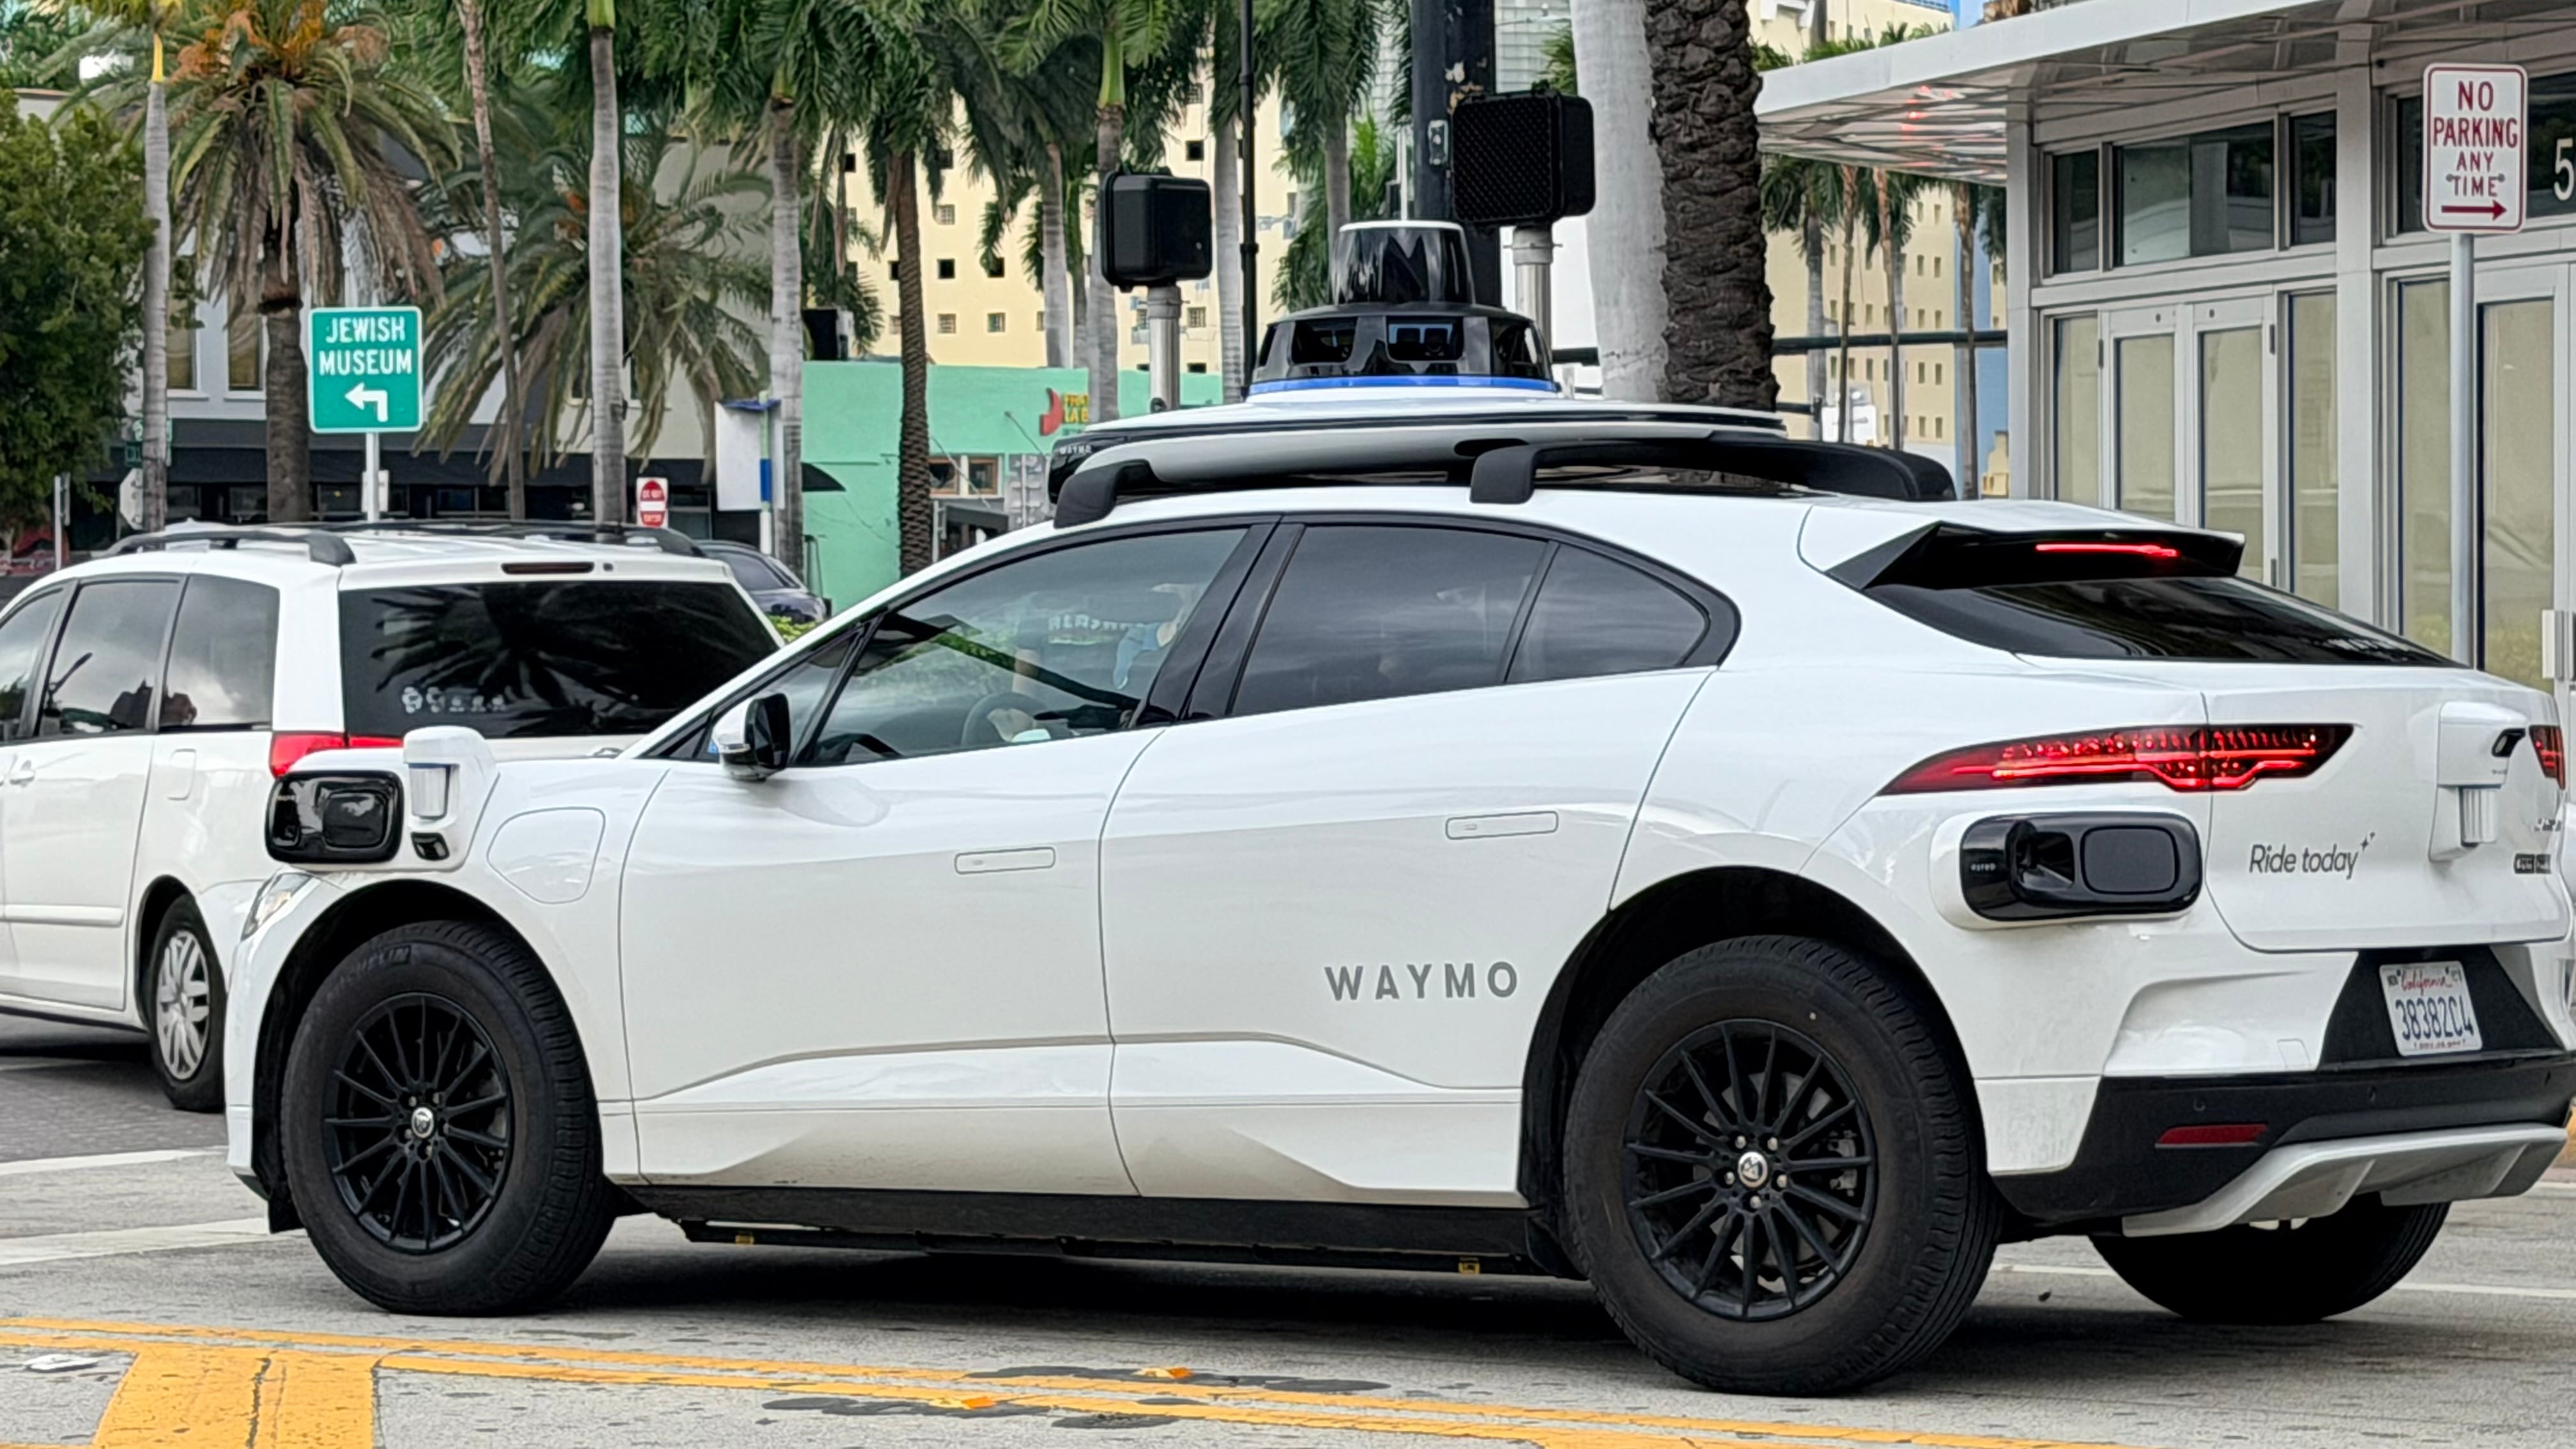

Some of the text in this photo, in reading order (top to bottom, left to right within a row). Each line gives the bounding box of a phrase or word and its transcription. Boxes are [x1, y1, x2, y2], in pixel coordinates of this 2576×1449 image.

[2458, 80, 2494, 112] NO
[2432, 116, 2518, 148] PARKING
[2456, 151, 2494, 172] ANY
[2554, 137, 2575, 201] 5
[2454, 175, 2499, 197] TIME
[325, 315, 406, 344] JEWISH
[318, 348, 413, 376] MUSEUM
[2248, 843, 2359, 880] Ride today
[1323, 960, 1518, 1001] WAYMO
[2401, 969, 2446, 997] California
[2395, 994, 2474, 1041] 38382C4
